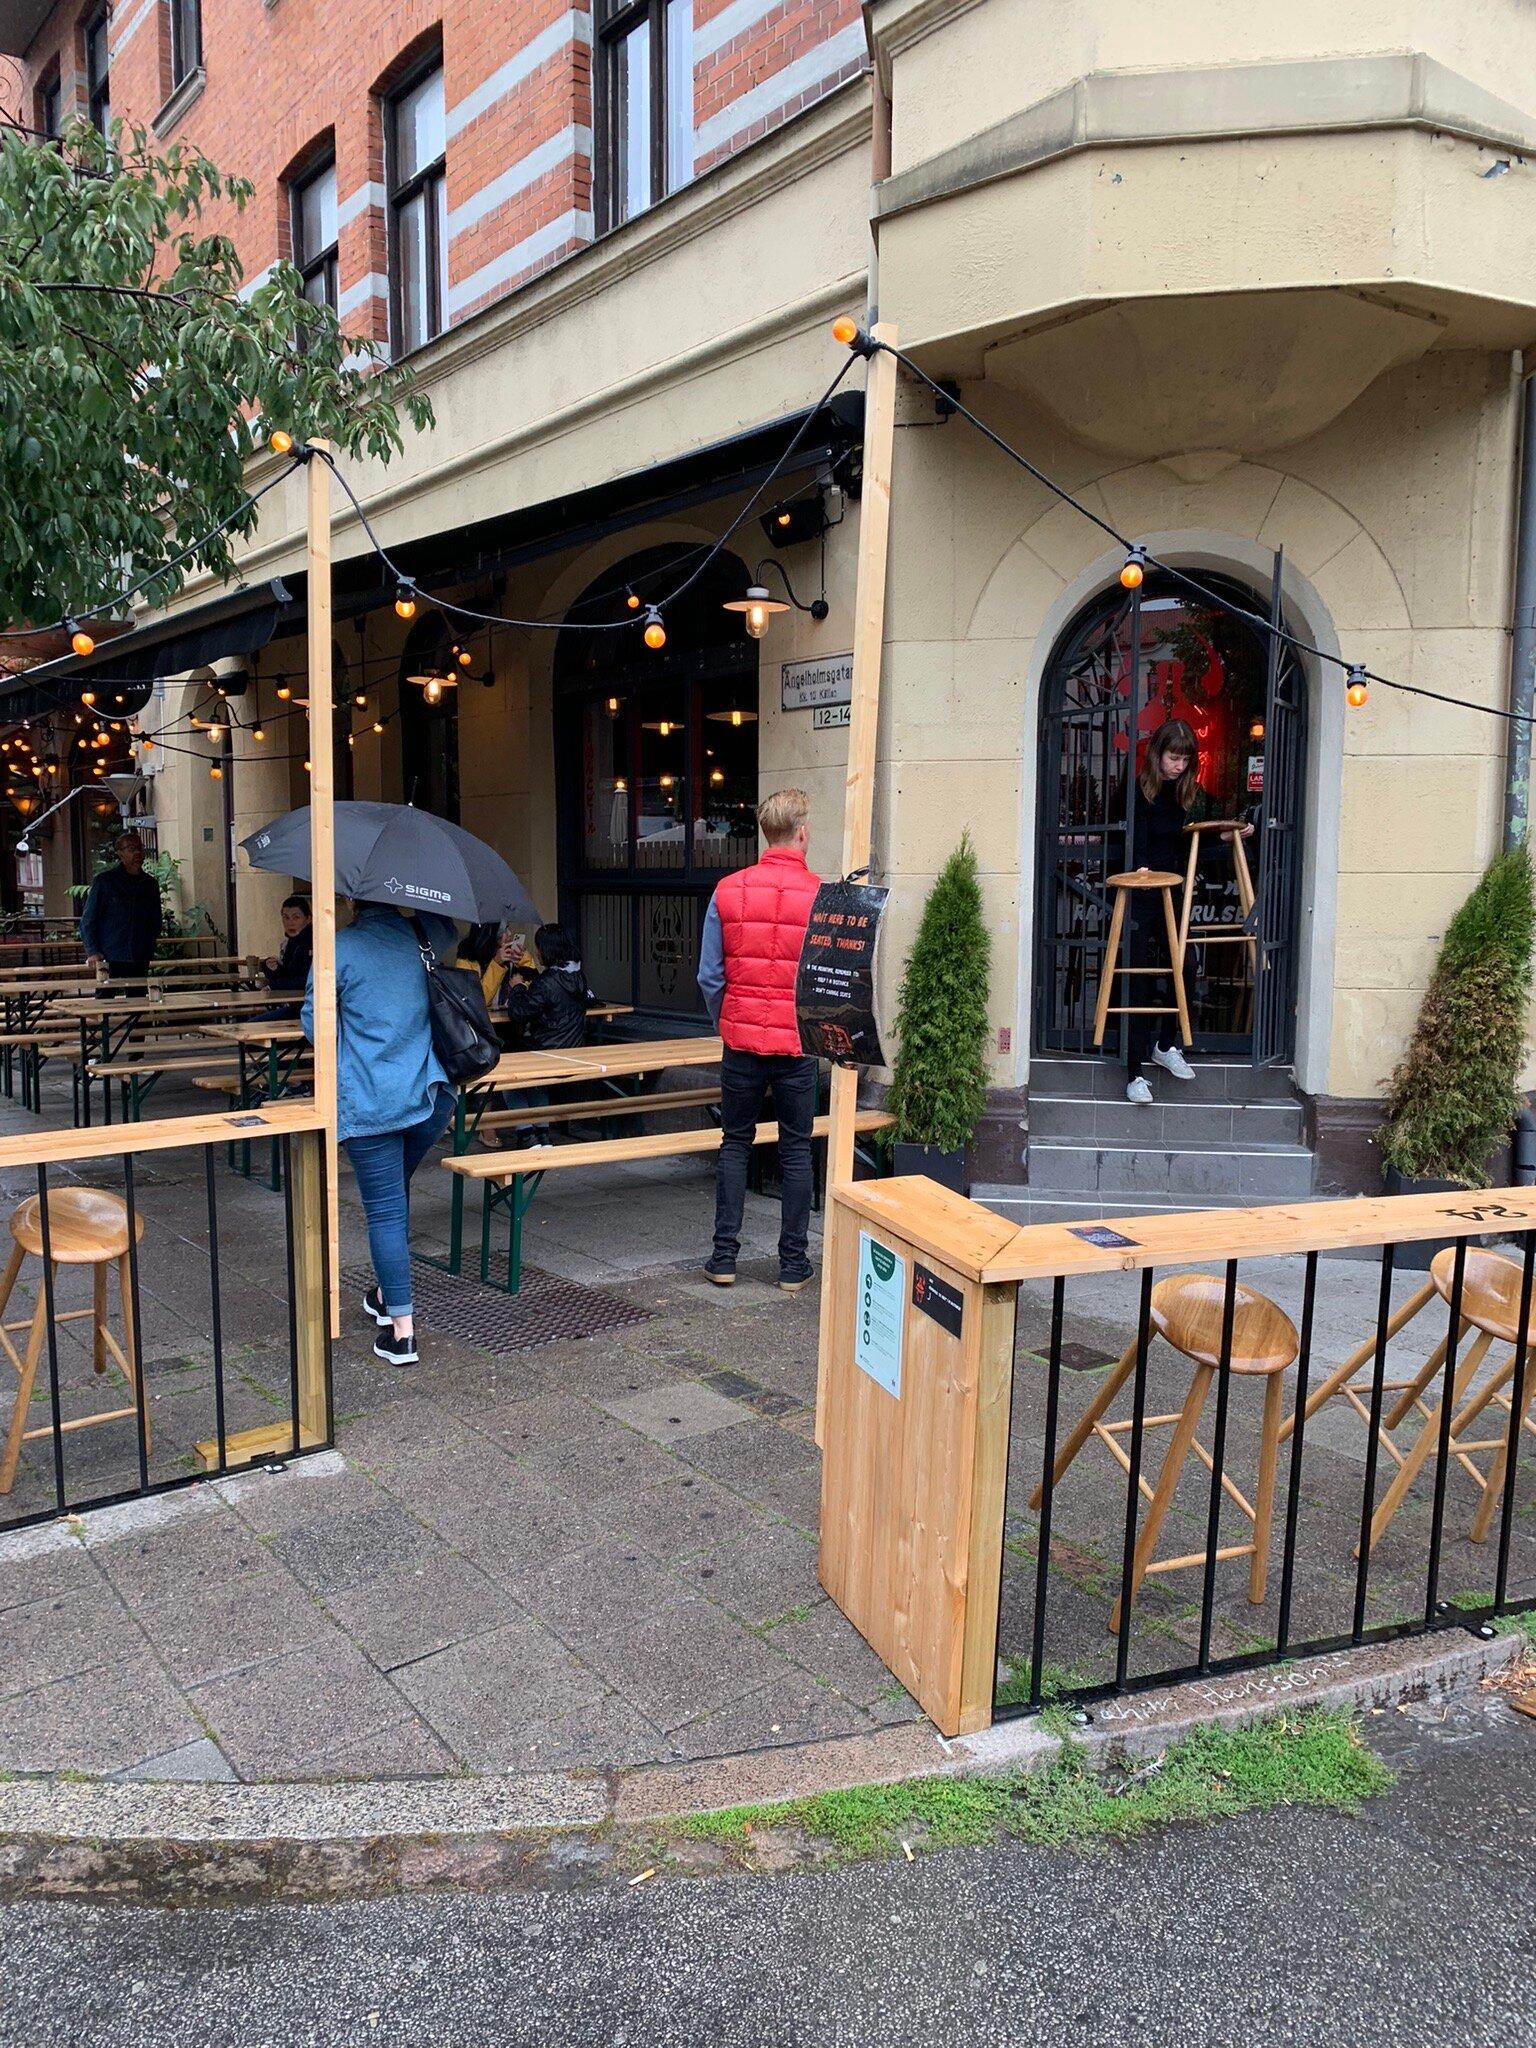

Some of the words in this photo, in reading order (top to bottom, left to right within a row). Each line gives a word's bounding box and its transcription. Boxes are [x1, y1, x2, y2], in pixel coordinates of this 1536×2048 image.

[819, 708, 850, 724] 12-14
[847, 915, 856, 926] TO
[857, 915, 869, 928] BE
